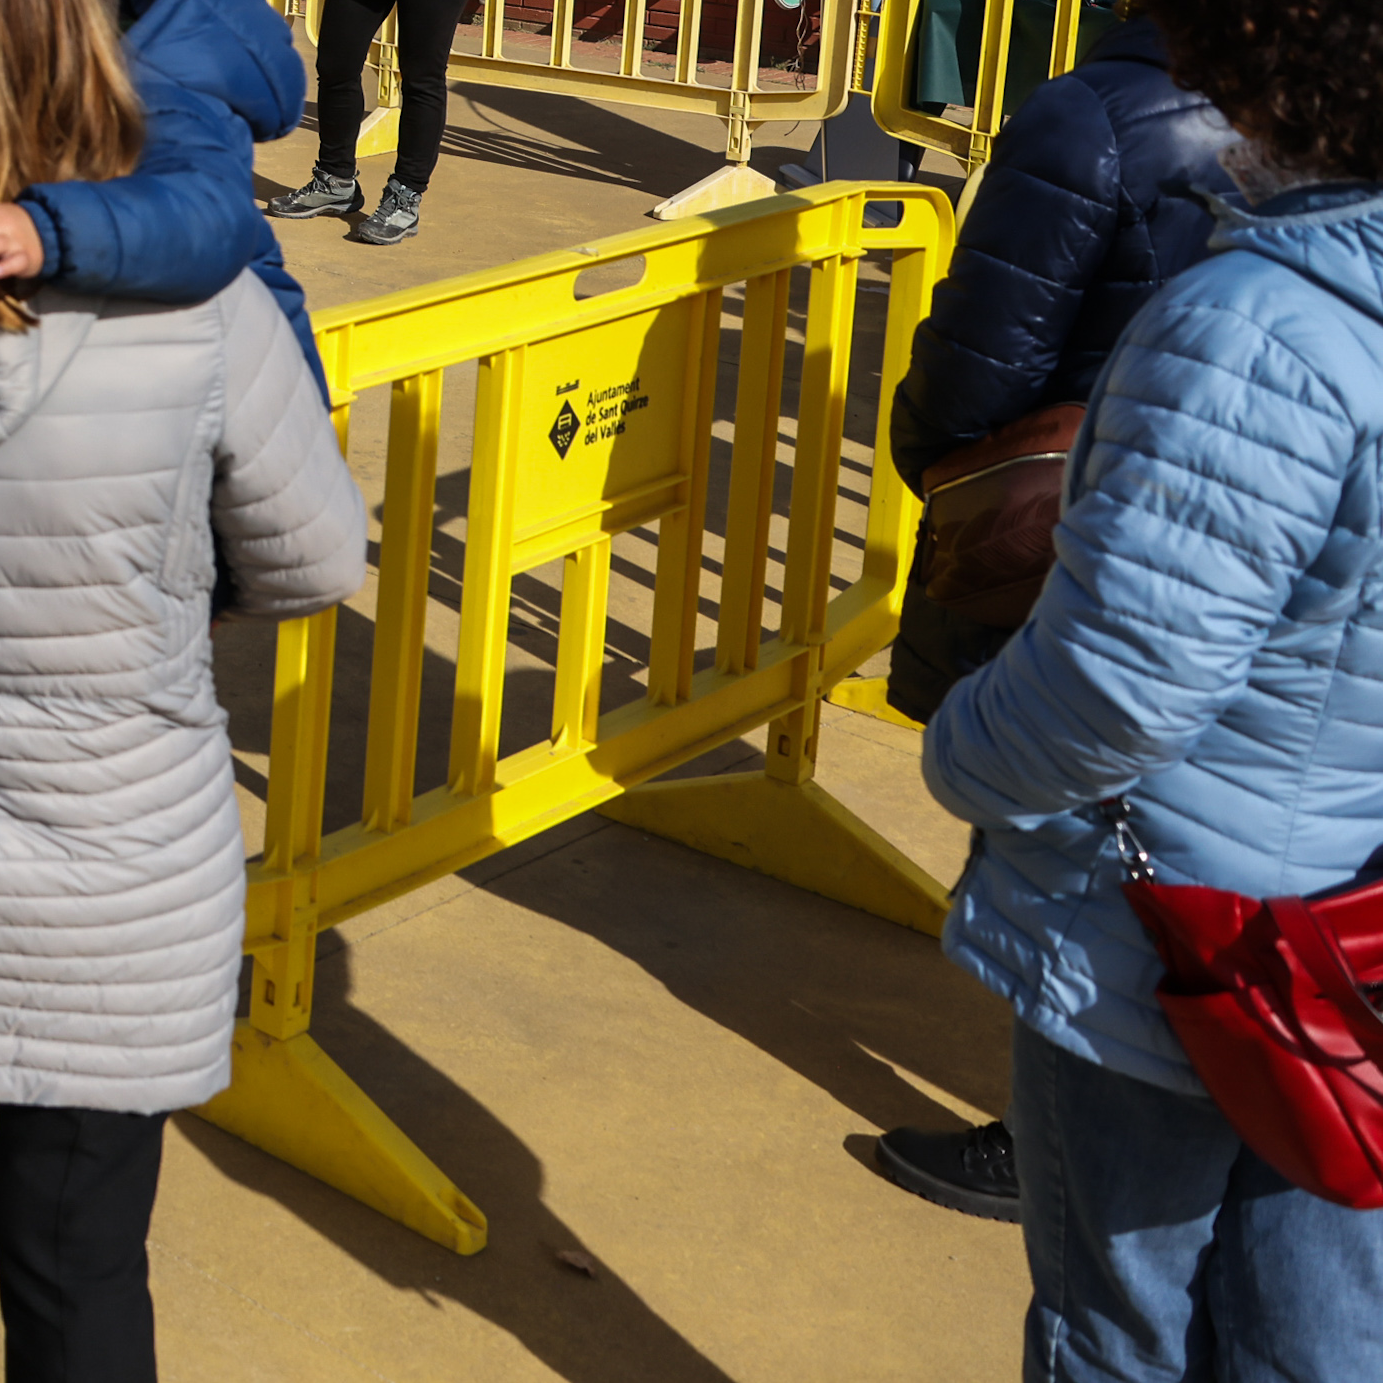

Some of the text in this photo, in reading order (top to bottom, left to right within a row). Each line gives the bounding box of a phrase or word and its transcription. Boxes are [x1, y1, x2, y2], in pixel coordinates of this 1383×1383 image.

[586, 377, 640, 408] Ajuntament
[585, 395, 649, 427] de Sant Quirze
[584, 419, 626, 446] del Vallès
